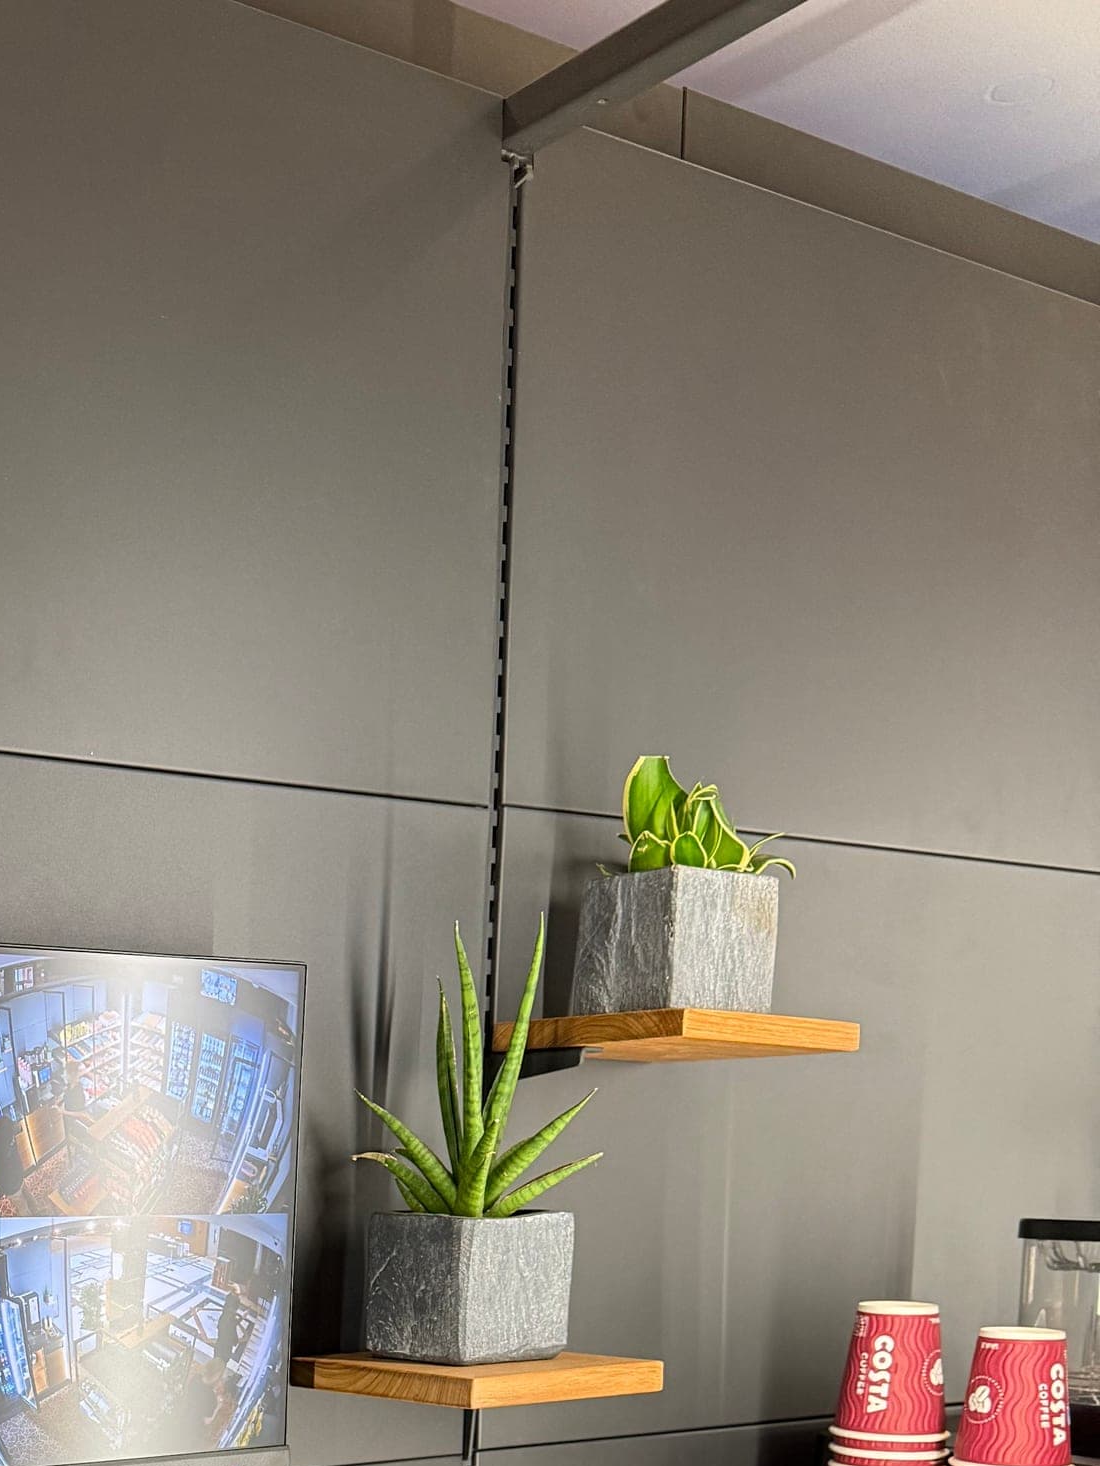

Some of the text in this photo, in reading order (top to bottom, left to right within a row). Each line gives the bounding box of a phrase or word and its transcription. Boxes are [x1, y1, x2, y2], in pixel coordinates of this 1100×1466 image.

[866, 1334, 895, 1414] COSTA
[1038, 1382, 1051, 1429] COFFEE
[1049, 1362, 1067, 1447] COSTA
